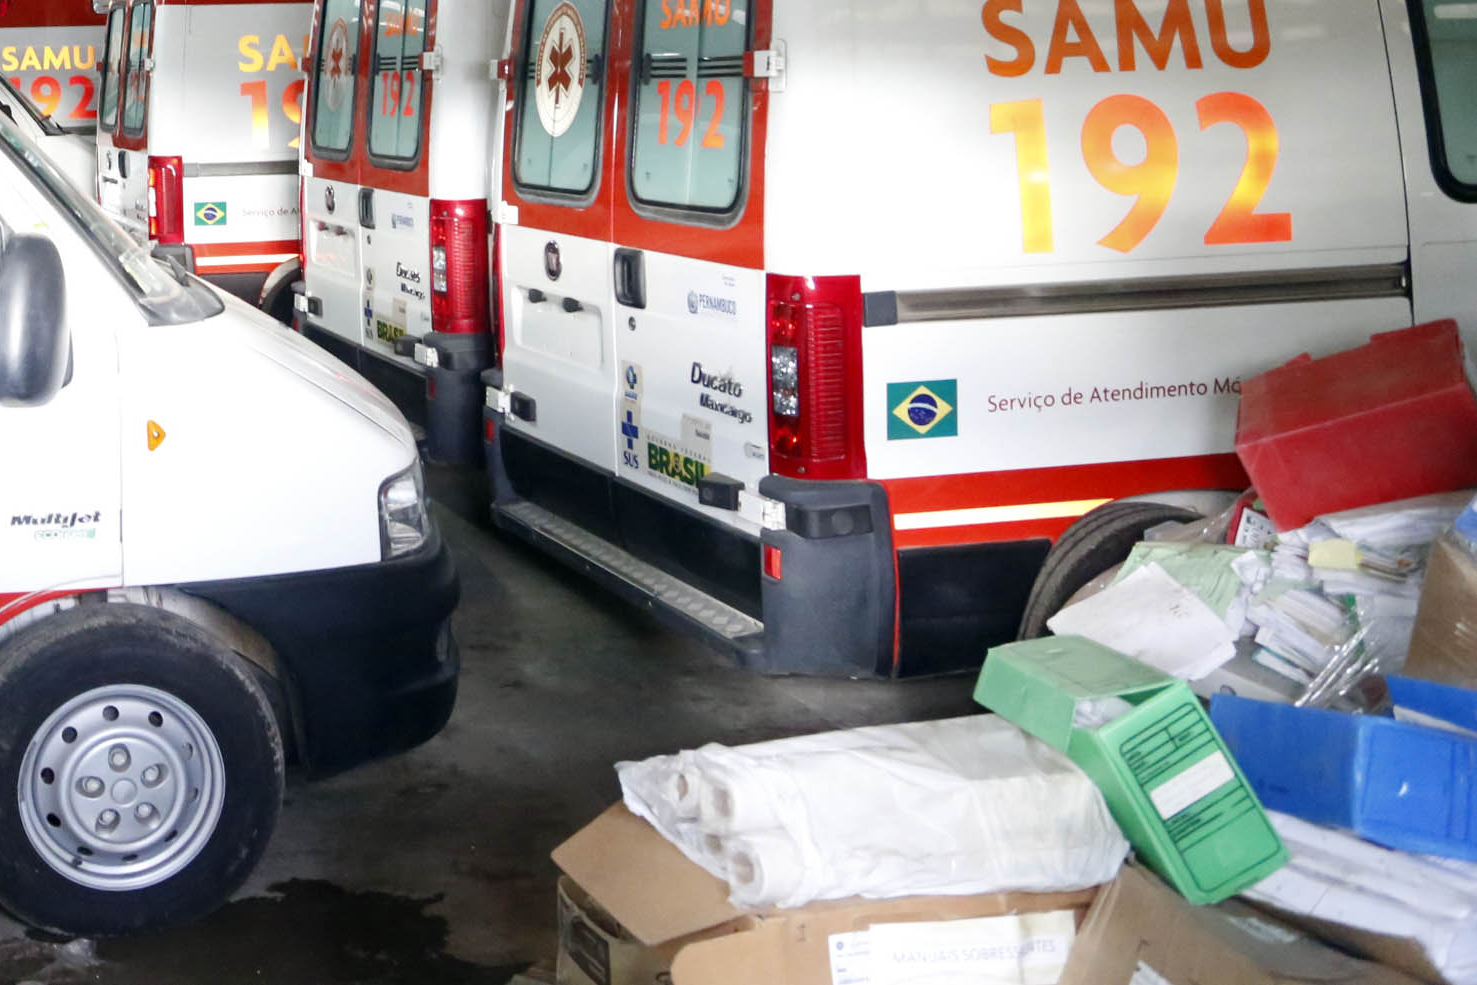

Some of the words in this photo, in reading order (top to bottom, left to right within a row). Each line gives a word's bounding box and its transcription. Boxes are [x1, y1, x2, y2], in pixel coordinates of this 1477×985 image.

[1, 45, 96, 71] SAMU
[237, 33, 309, 73] SA
[381, 70, 415, 118] 192
[657, 79, 726, 149] 192
[988, 91, 1292, 254] 192
[276, 207, 289, 216] de
[691, 362, 742, 397] Ducato
[987, 394, 1055, 413] Serviço
[1061, 387, 1083, 406] de
[1090, 381, 1208, 403] Atendimento
[624, 450, 639, 469] SUS
